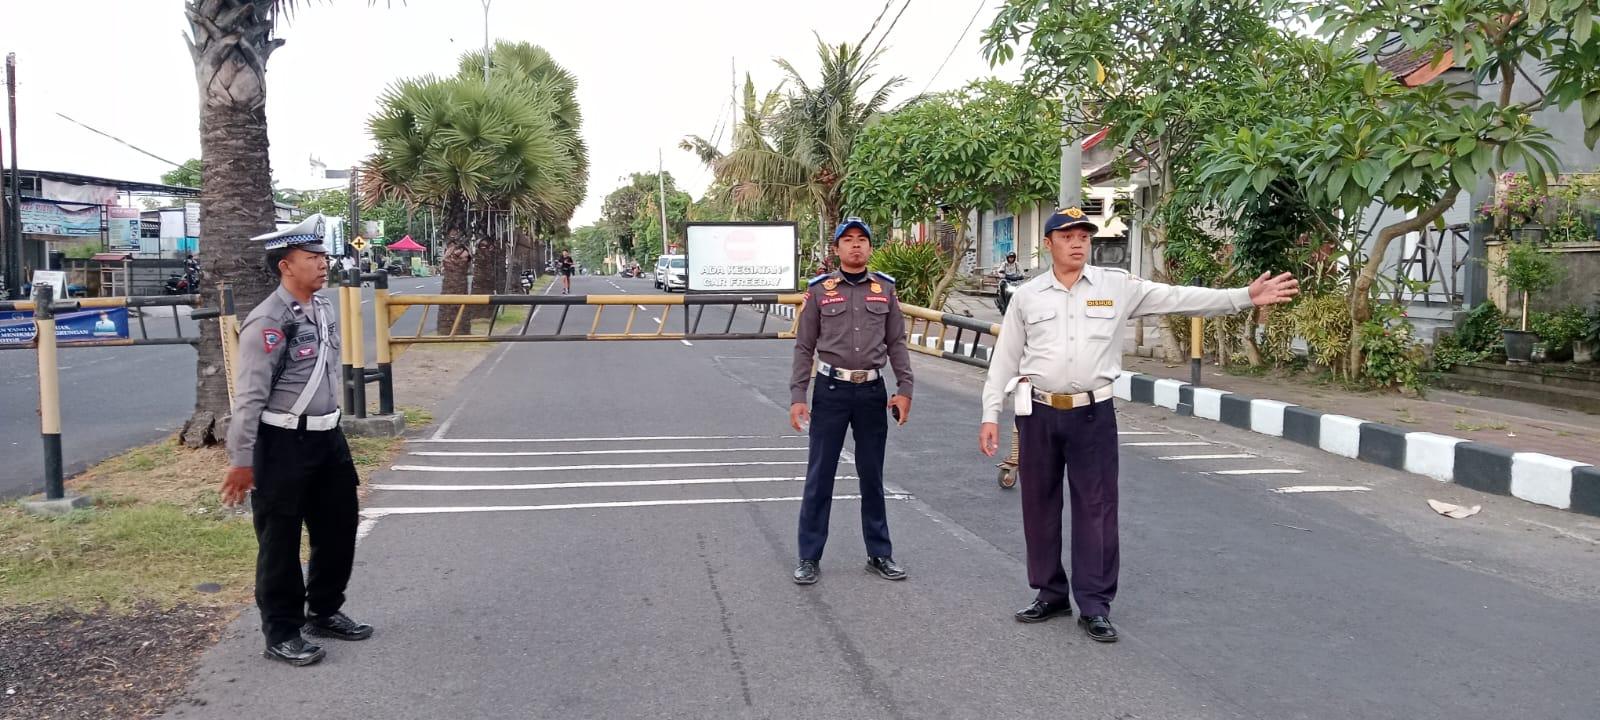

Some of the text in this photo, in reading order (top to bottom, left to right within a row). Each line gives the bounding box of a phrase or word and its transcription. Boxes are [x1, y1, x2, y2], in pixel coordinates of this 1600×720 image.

[700, 265, 725, 275] ADA
[703, 277, 782, 287] CAR FREEDAY
